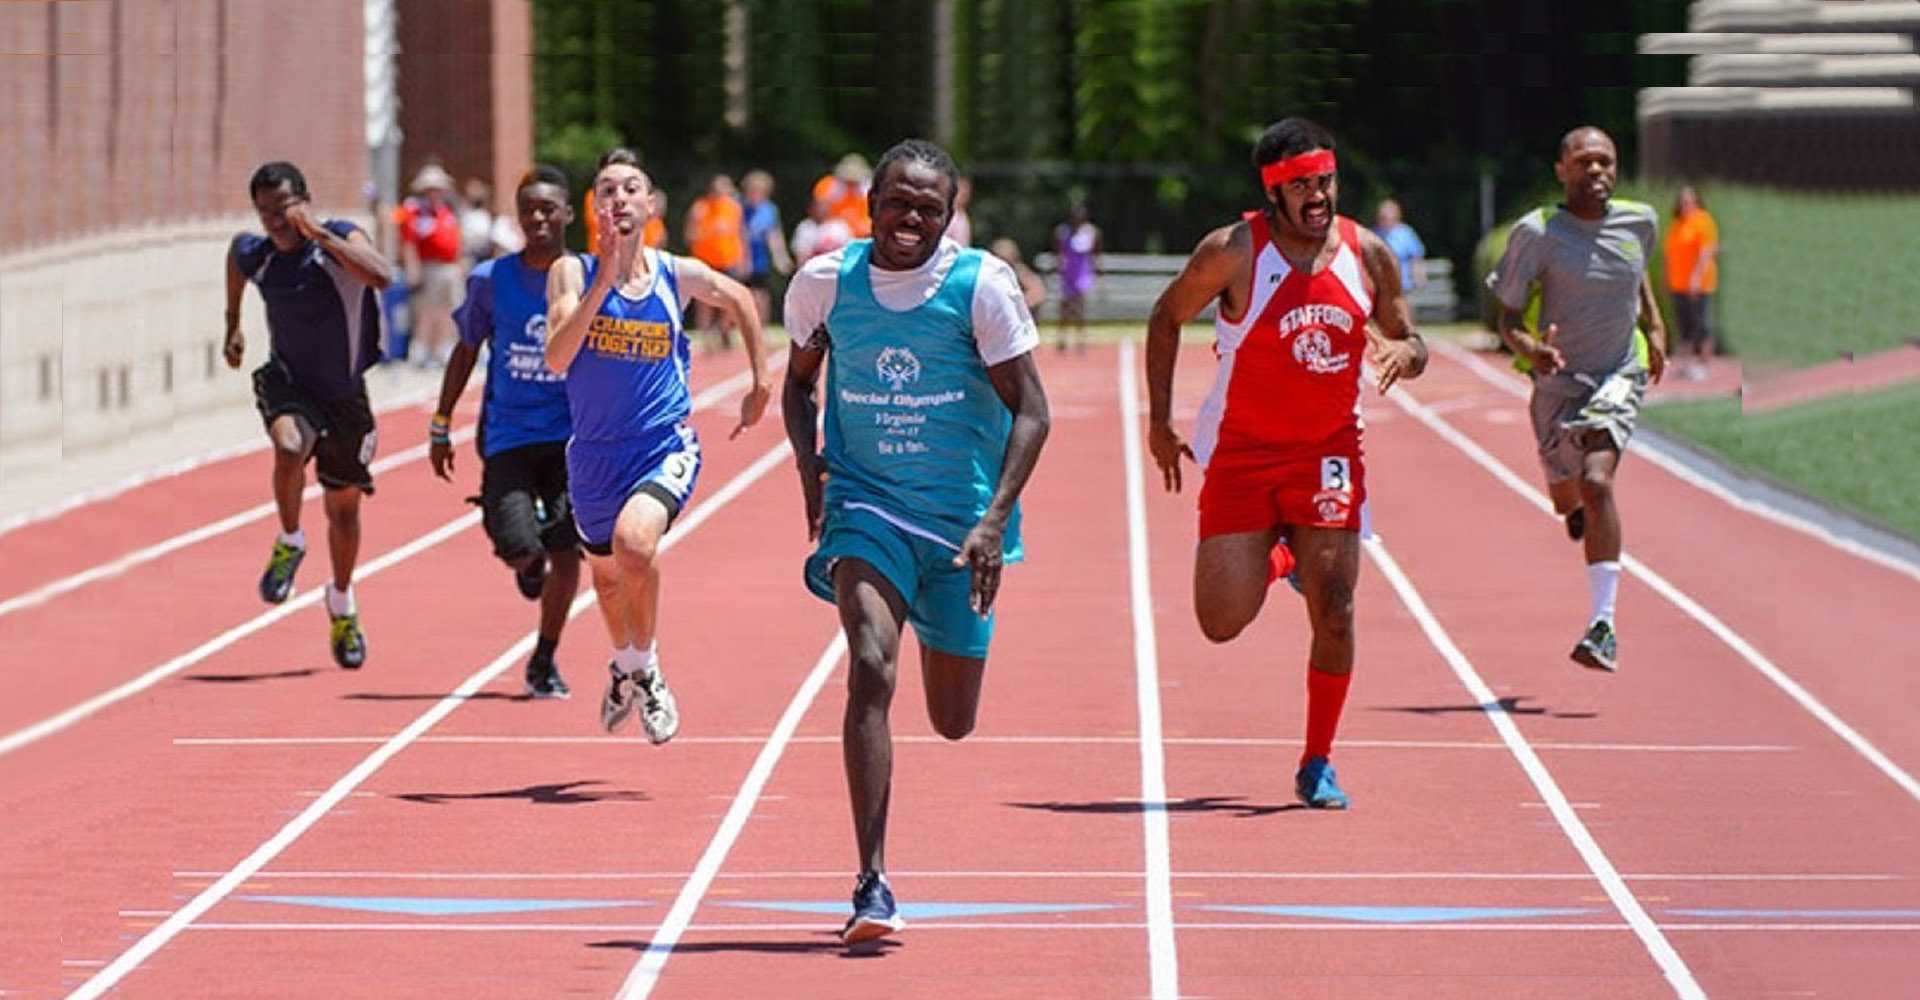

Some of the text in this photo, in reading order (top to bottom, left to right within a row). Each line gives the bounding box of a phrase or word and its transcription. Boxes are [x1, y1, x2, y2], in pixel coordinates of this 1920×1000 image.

[593, 315, 671, 339] CHAMPIONS
[1279, 304, 1353, 338] STAFFORD
[586, 332, 671, 358] TOGETHER
[841, 389, 965, 408] Special Olympics
[875, 412, 927, 427] Virginia
[1327, 459, 1344, 490] 3
